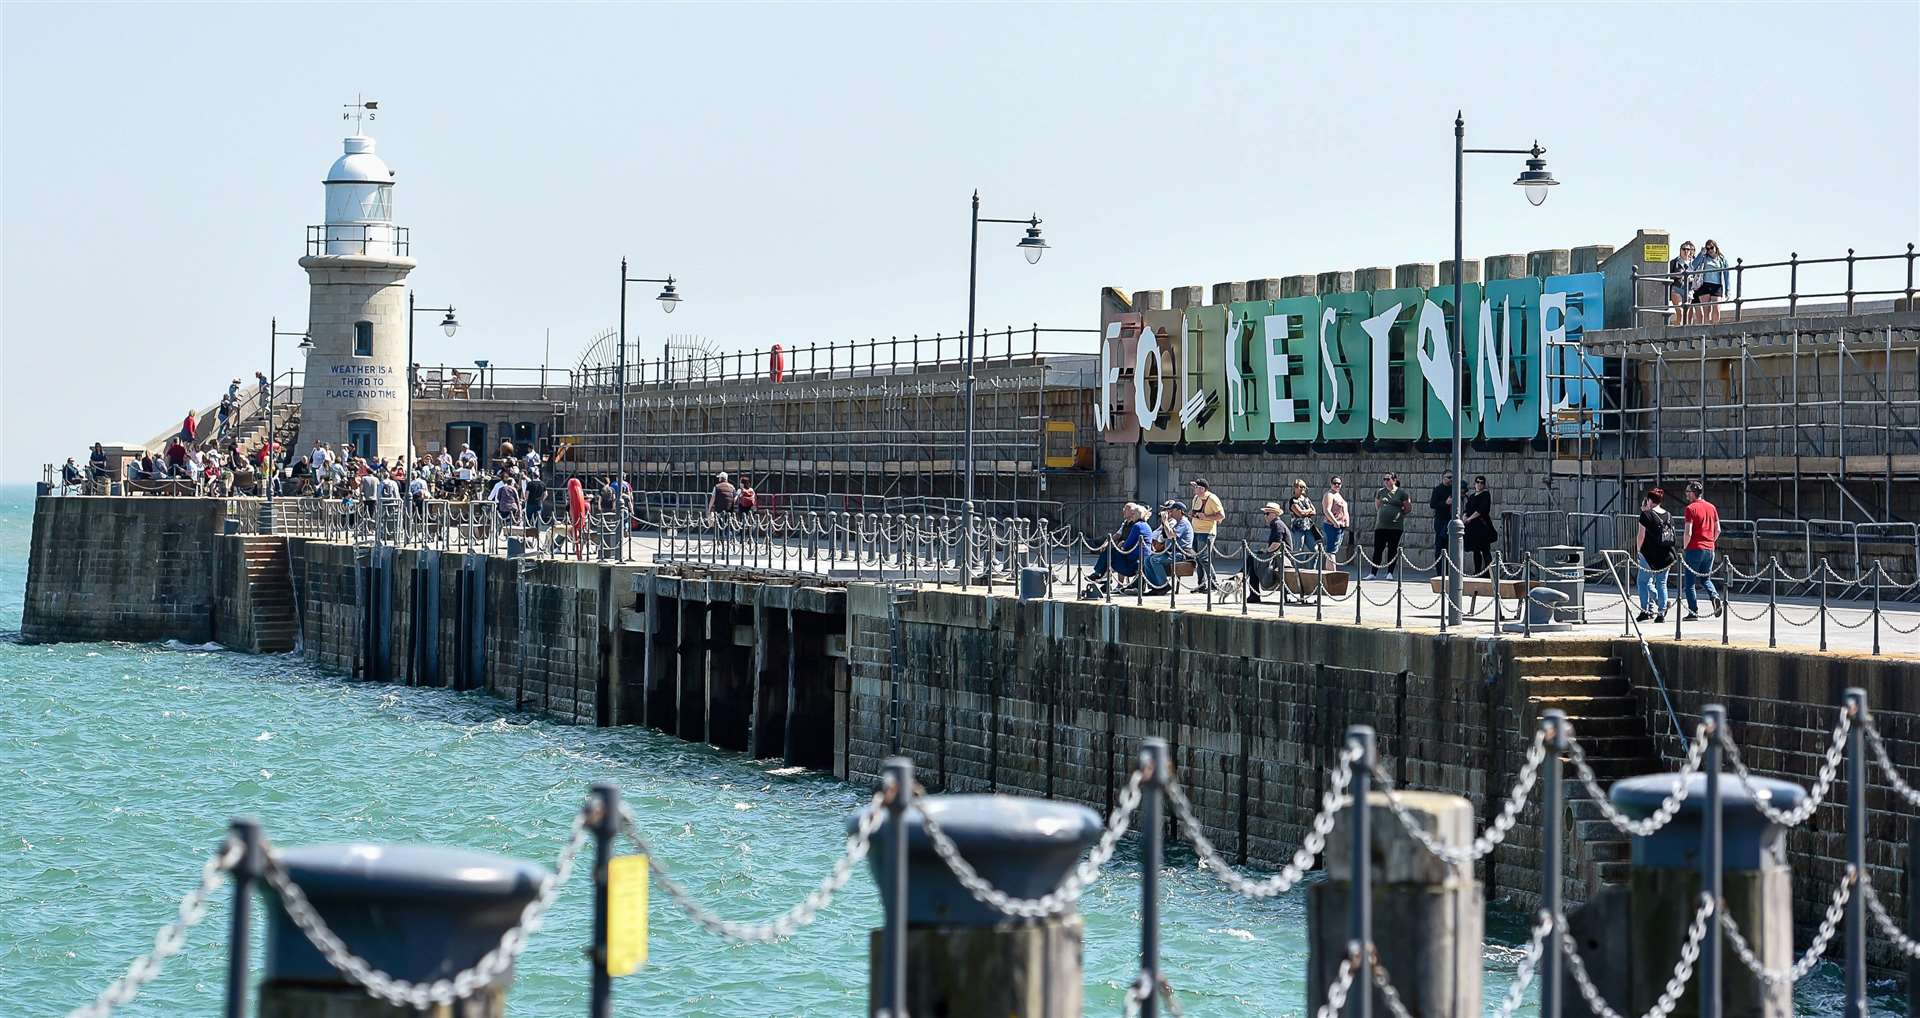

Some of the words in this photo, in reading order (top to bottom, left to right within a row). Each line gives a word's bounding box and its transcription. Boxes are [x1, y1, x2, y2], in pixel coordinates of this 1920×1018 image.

[369, 113, 376, 121] S
[1094, 293, 1568, 432] FOLKESTONE
[331, 365, 376, 374] WEATHER
[378, 365, 386, 374] IS
[387, 366, 393, 374] A
[341, 377, 371, 386] THIRD
[373, 377, 384, 386] TO
[326, 389, 355, 398] PLACE
[357, 390, 377, 399] AND
[378, 390, 396, 399] TIME
